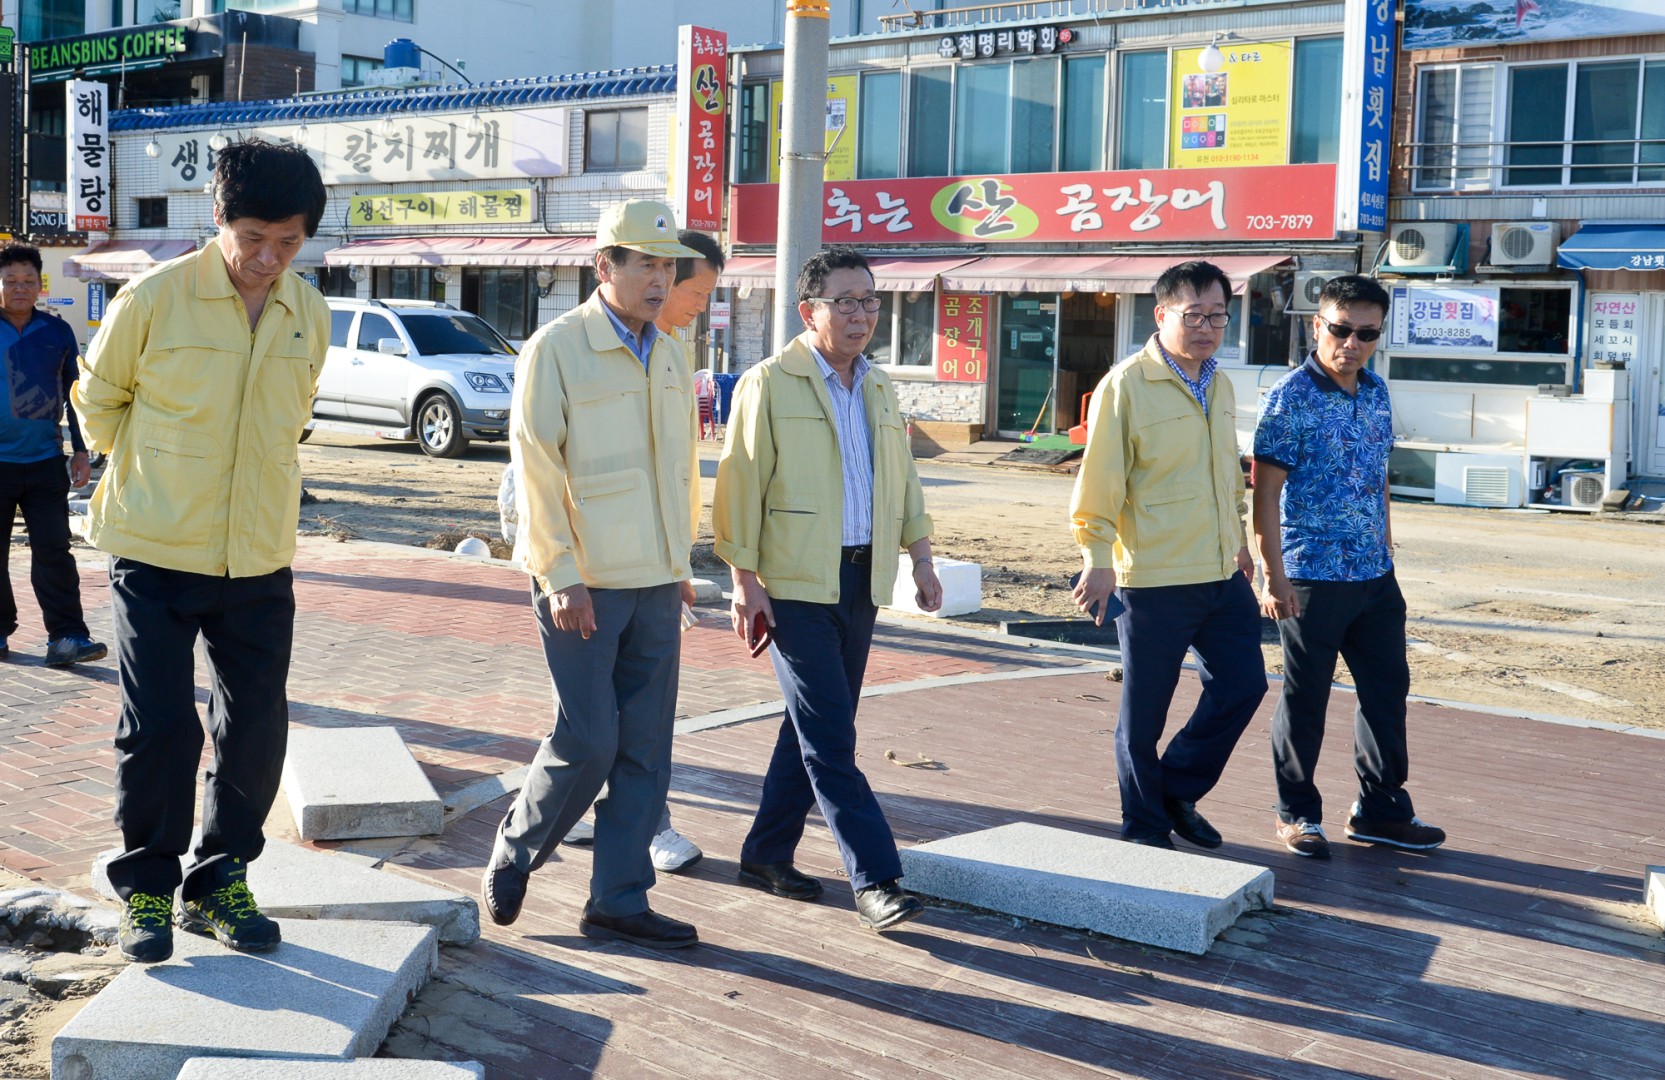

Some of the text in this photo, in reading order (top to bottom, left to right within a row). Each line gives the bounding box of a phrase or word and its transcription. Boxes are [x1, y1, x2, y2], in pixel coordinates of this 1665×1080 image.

[31, 27, 187, 70] BEANSBINS COFFEE
[693, 32, 725, 57] 춤추는
[938, 27, 1055, 57] 유천명리학회
[1241, 52, 1261, 62] 타로
[77, 90, 106, 213] 해물탕
[693, 120, 717, 215] 곰장어
[30, 210, 57, 226] SONG
[356, 197, 435, 222] 생선구이
[458, 194, 522, 219] 해물찜
[823, 188, 914, 233] 추는
[1055, 178, 1228, 232] 곰장어
[1246, 214, 1313, 230] 703-7879
[690, 217, 718, 229] 703-7879
[1413, 301, 1474, 320] 강남횟집
[1594, 302, 1636, 315] 자연산
[1594, 319, 1633, 329] 모듬회
[942, 296, 960, 380] 곰장어
[964, 297, 984, 381] 조개구이
[1594, 335, 1632, 346] 세꼬시
